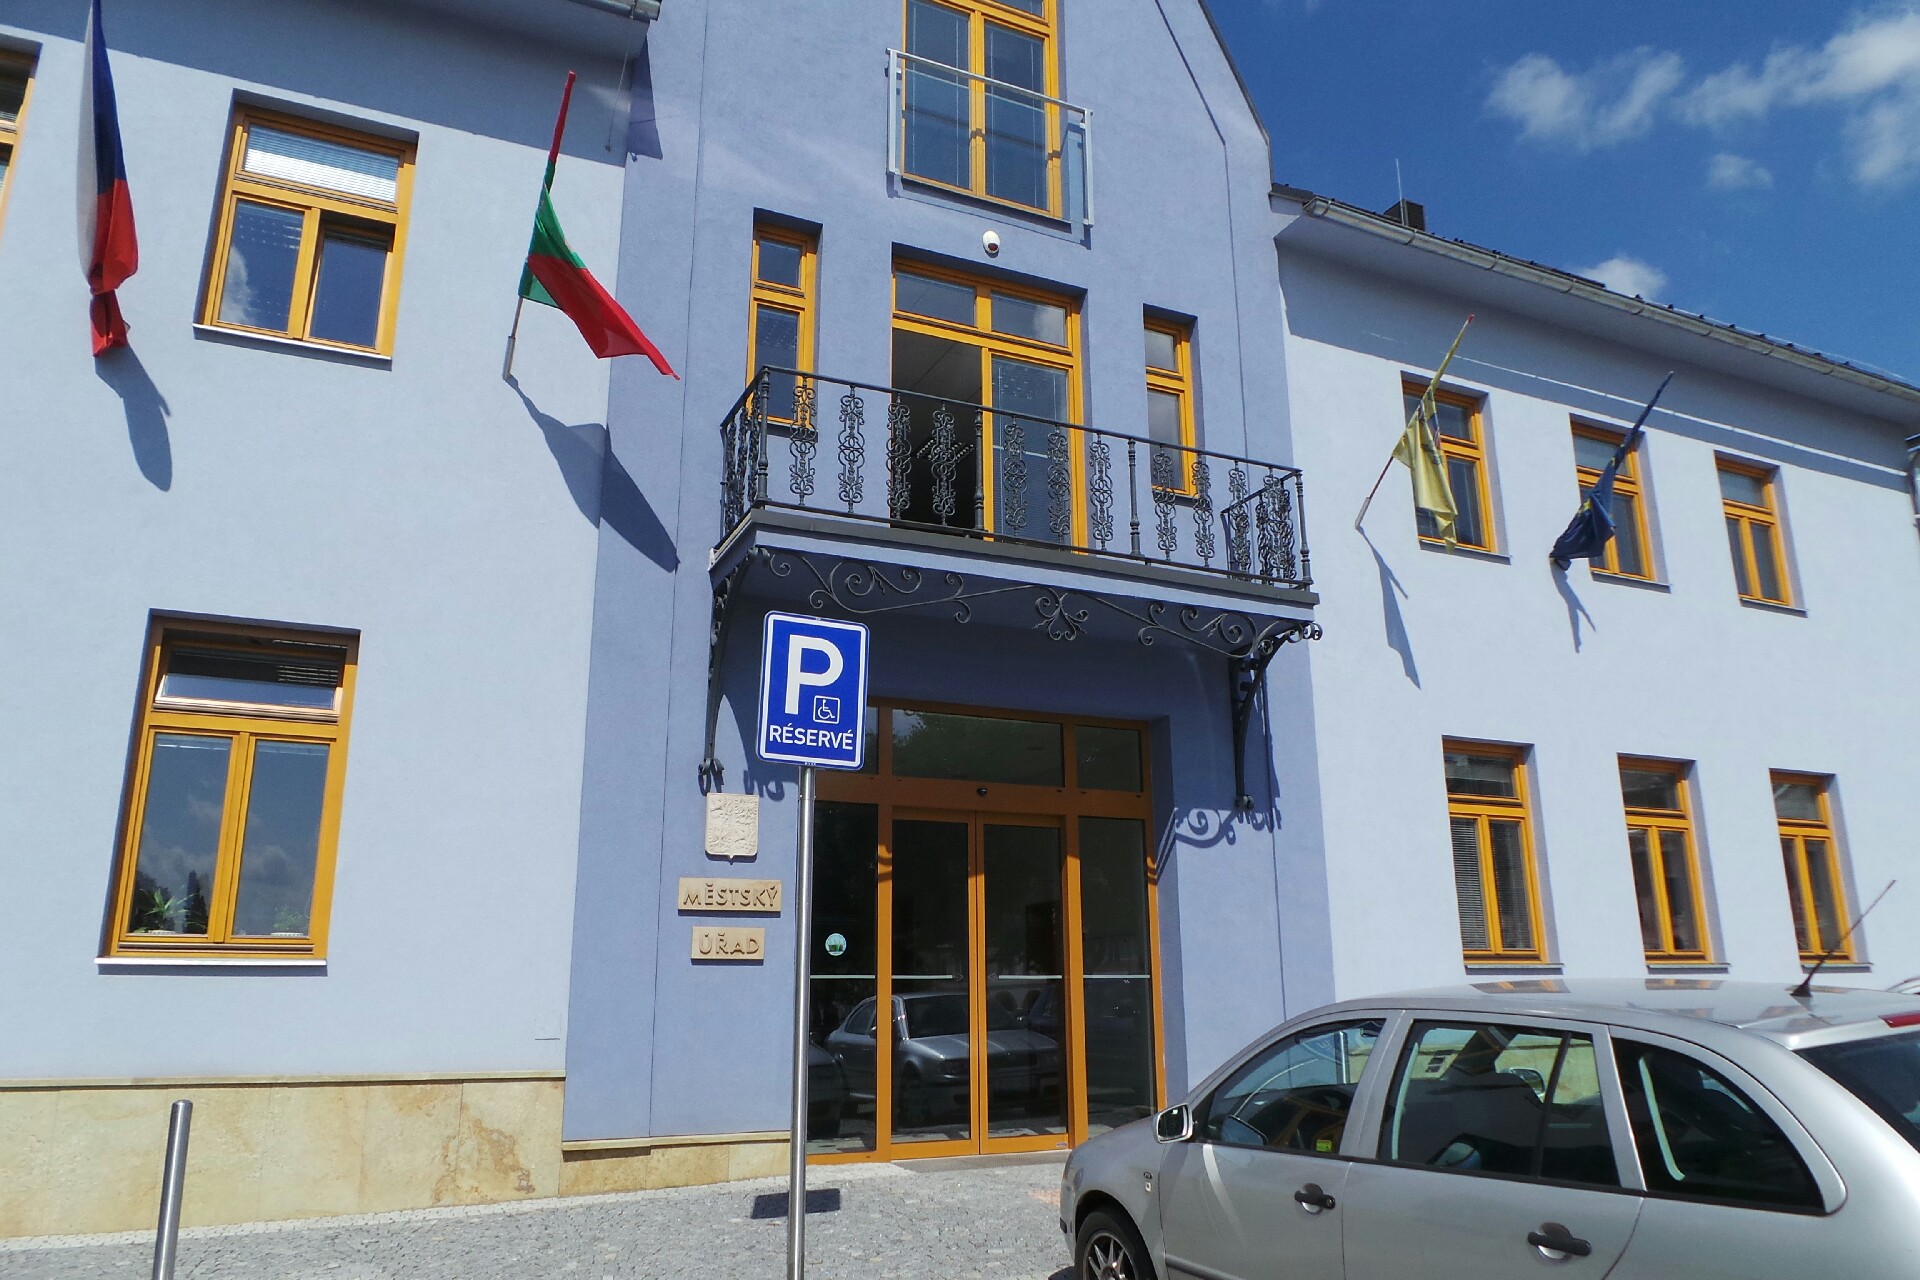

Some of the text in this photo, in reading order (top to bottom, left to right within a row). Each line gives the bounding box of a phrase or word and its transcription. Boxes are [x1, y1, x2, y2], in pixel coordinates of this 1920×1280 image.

[785, 634, 844, 715] P
[769, 723, 853, 750] RÉSERVÉ
[683, 882, 778, 907] MĚSTSKÝ
[699, 932, 760, 956] ÚŘAD
